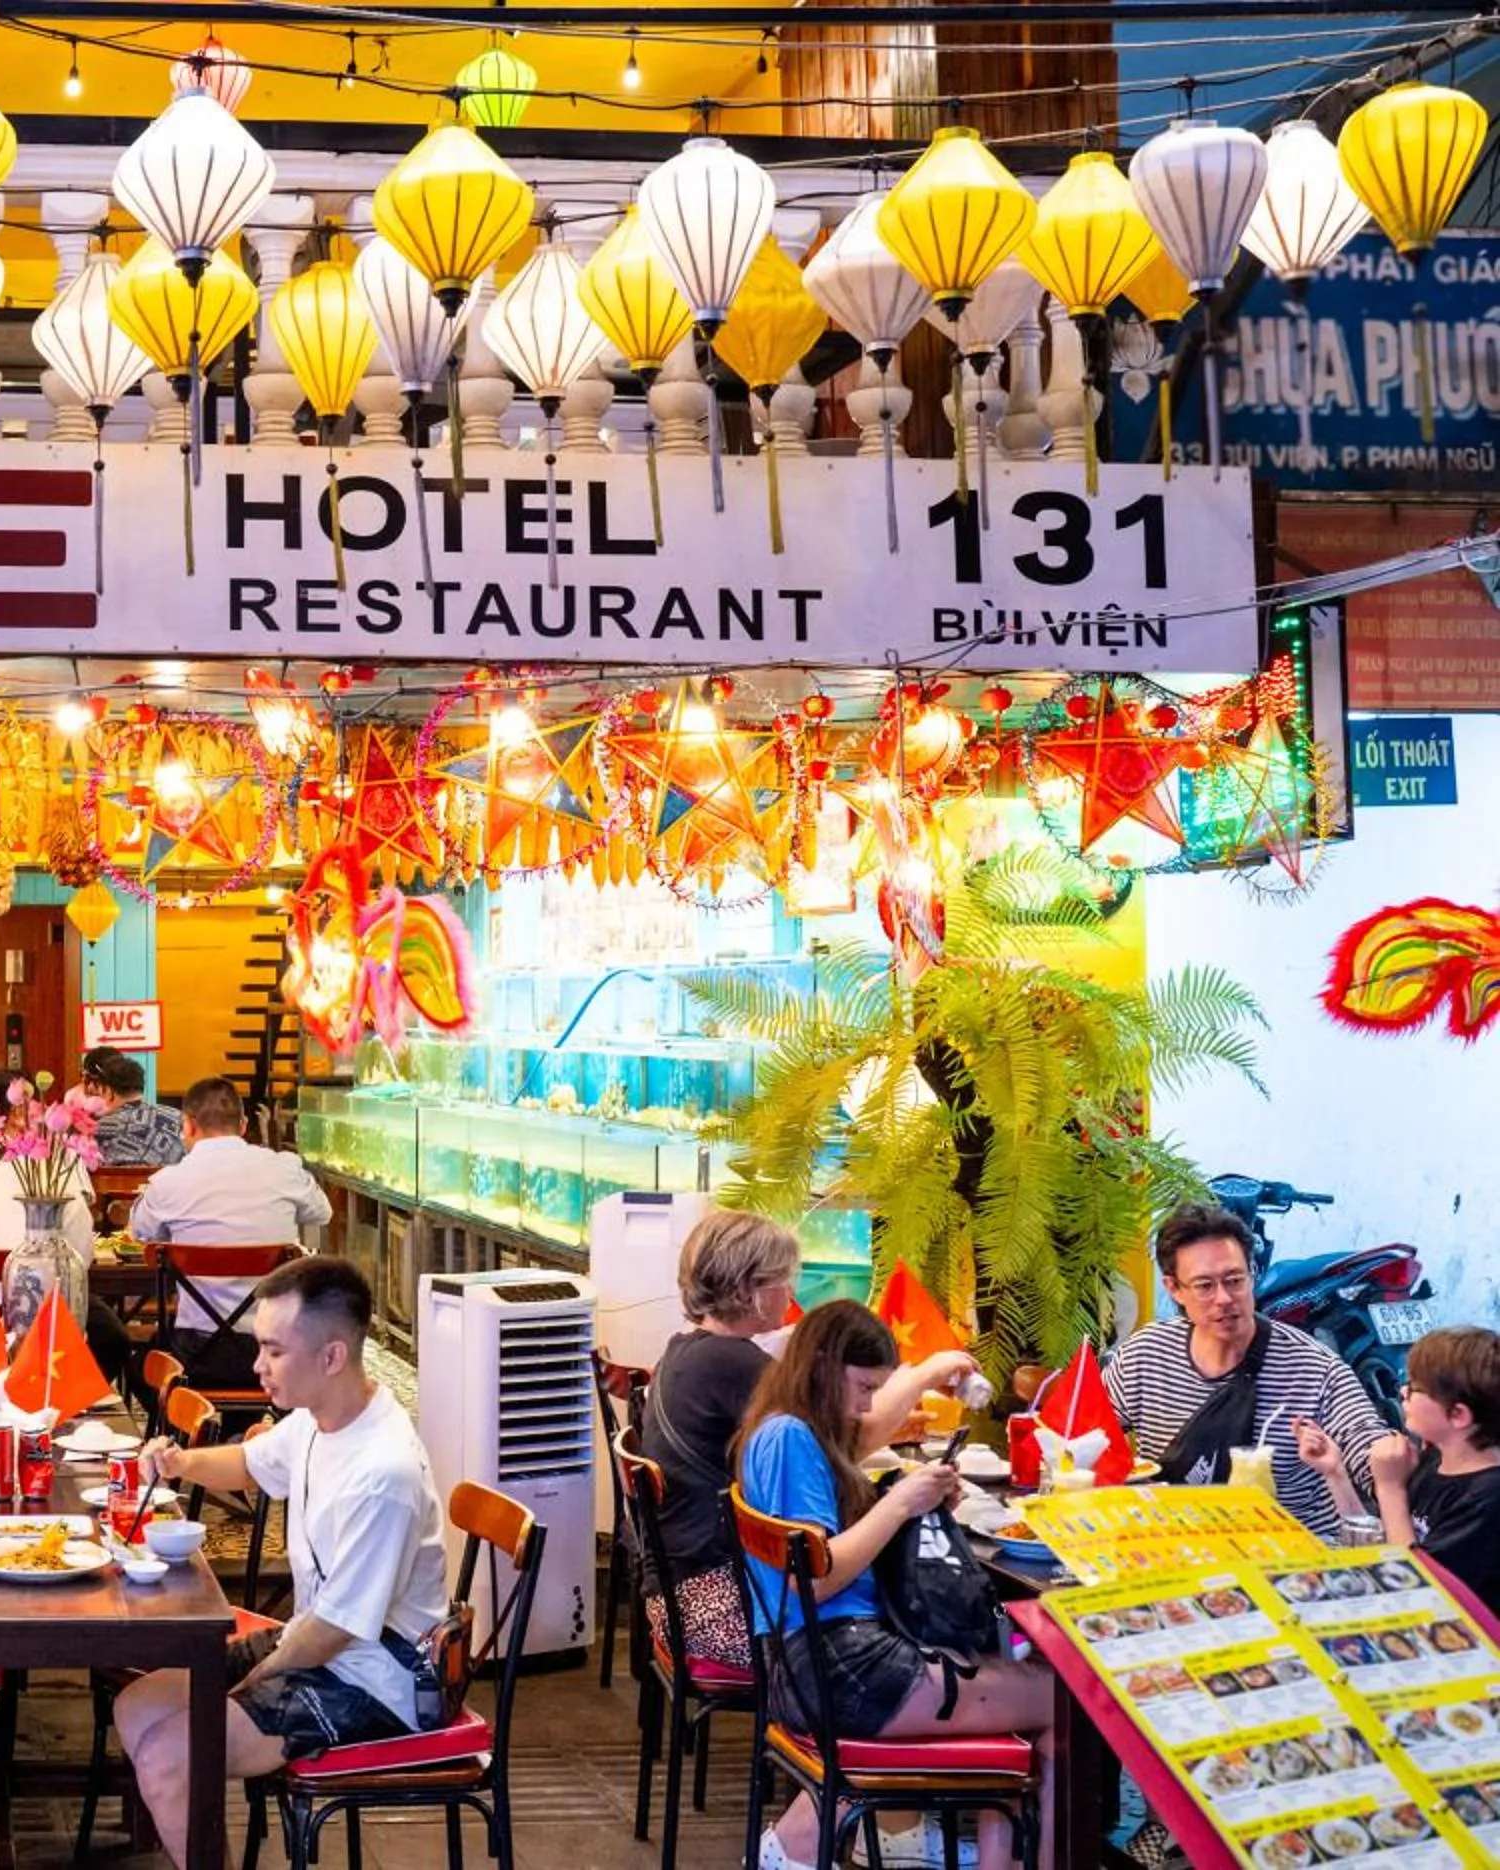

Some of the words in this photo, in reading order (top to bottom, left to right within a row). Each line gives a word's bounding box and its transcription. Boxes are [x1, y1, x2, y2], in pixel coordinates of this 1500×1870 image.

[1433, 249, 1500, 284] GIÁ
[225, 473, 658, 556] HOTEL
[928, 489, 1168, 589] 131
[228, 577, 823, 642] RESTAURANT
[1041, 602, 1167, 656] VIỆN
[1355, 729, 1386, 768] LỐI
[1390, 732, 1450, 767] THOÁT
[1385, 777, 1427, 800] EXIT
[100, 1009, 143, 1032] WC
